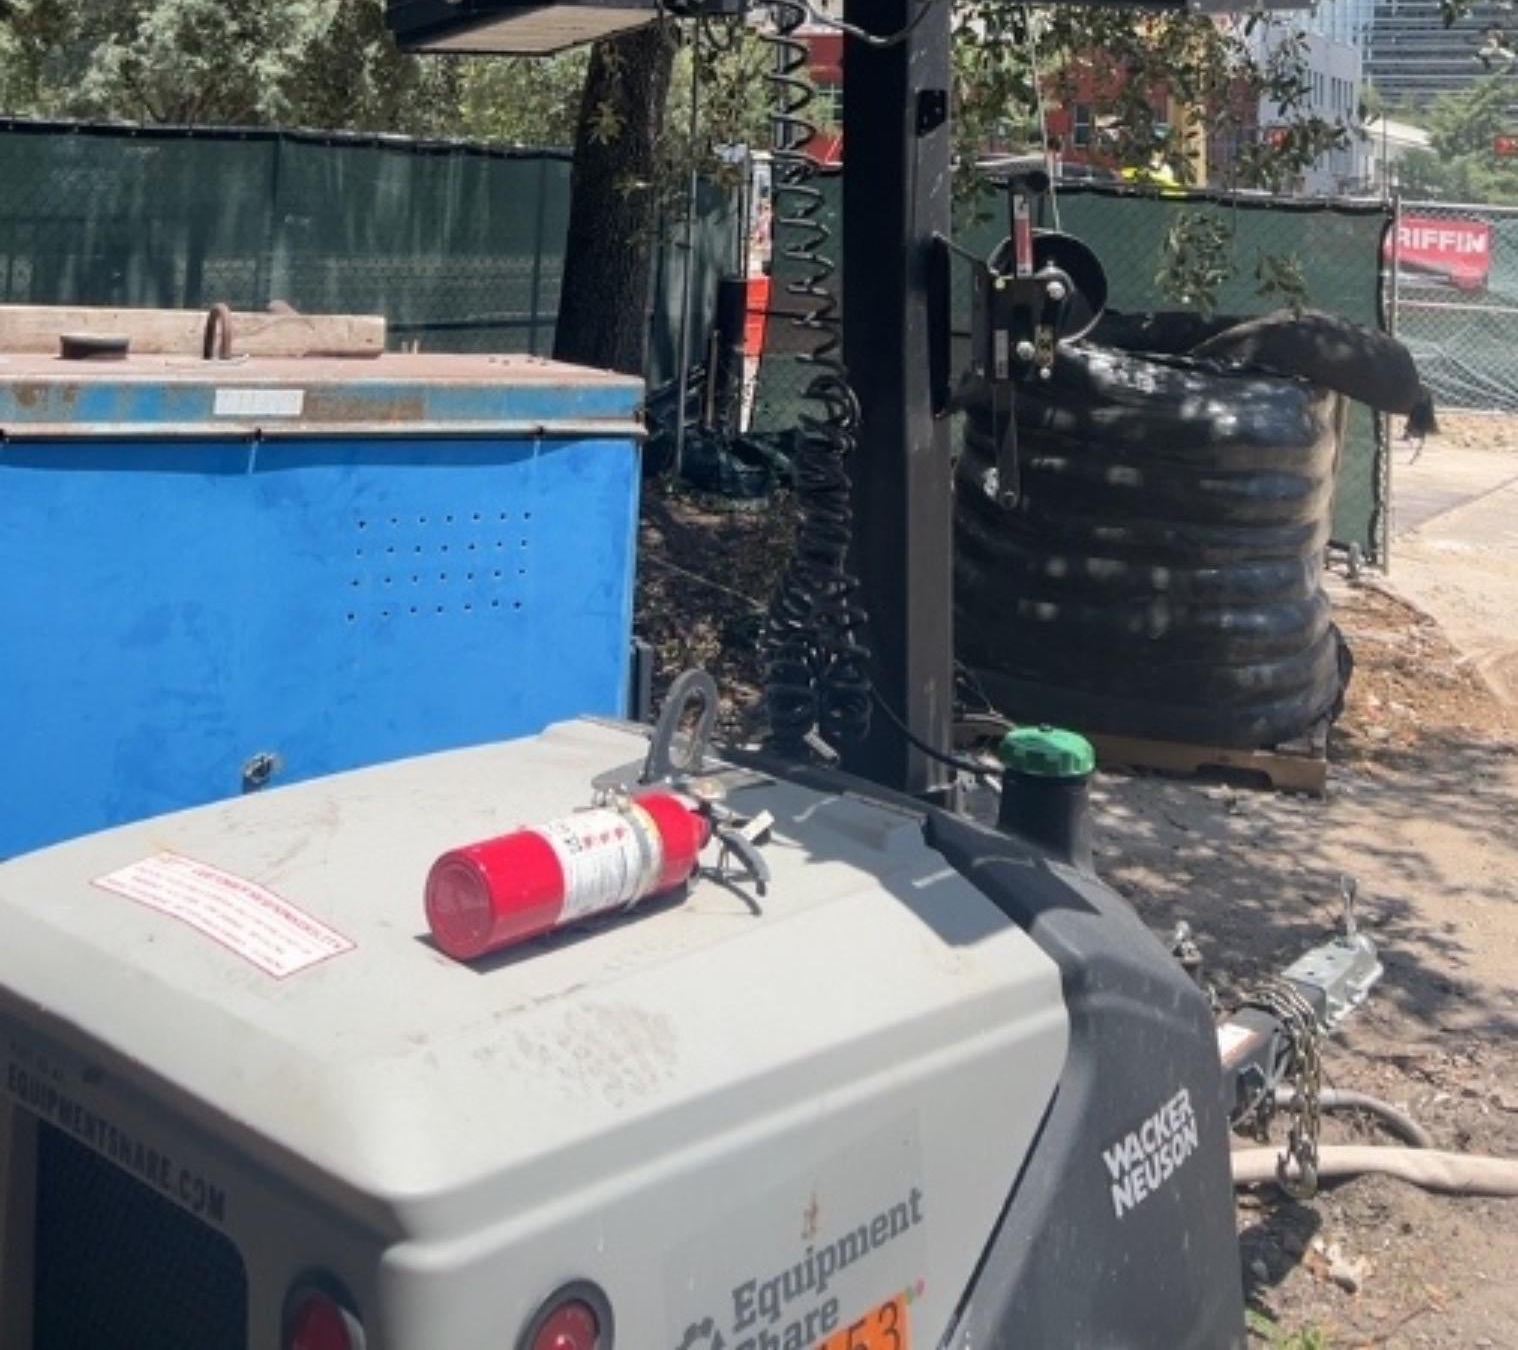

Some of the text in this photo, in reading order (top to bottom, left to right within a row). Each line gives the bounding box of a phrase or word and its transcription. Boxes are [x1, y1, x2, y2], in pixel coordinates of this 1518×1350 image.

[1102, 1088, 1194, 1180] WACKER
[1111, 1117, 1198, 1220] NEUSON
[732, 1186, 923, 1333] Equipment
